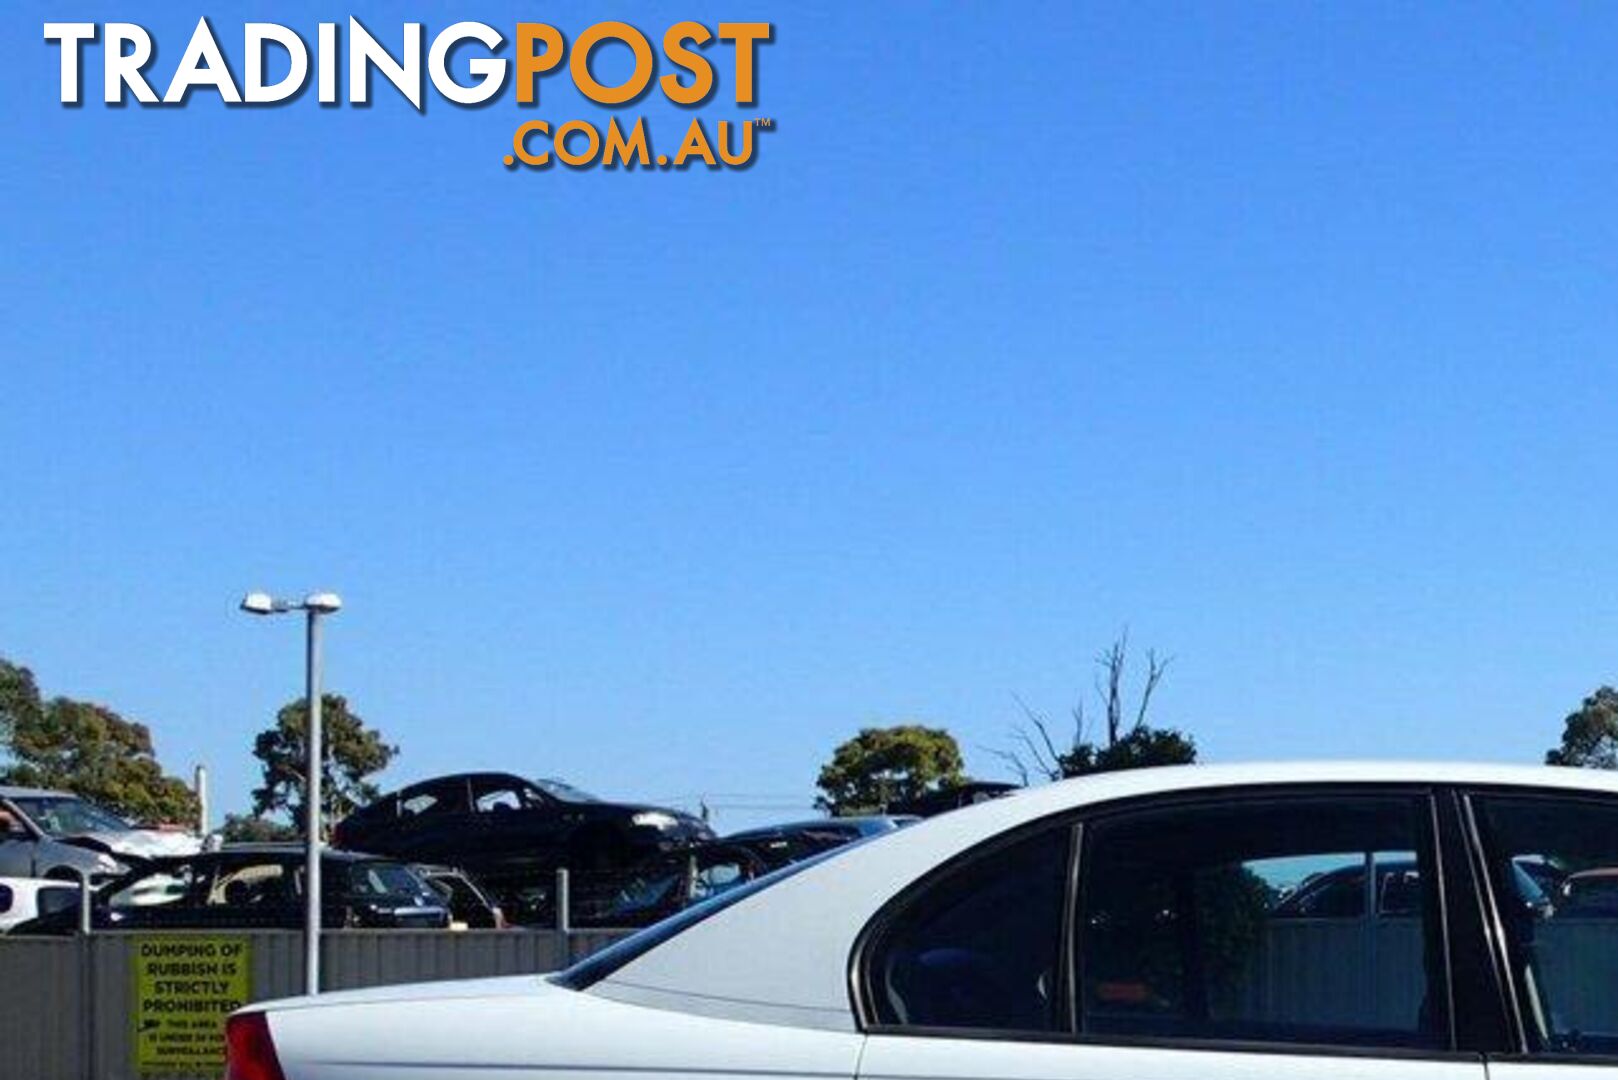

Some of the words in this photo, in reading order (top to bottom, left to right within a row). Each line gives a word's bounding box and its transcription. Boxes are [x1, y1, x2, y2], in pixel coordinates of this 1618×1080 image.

[140, 943, 217, 957] DUMPING
[220, 944, 243, 957] OF
[147, 963, 217, 976] RUBBISH
[221, 963, 237, 976] IS
[154, 981, 230, 994] STRICTLY
